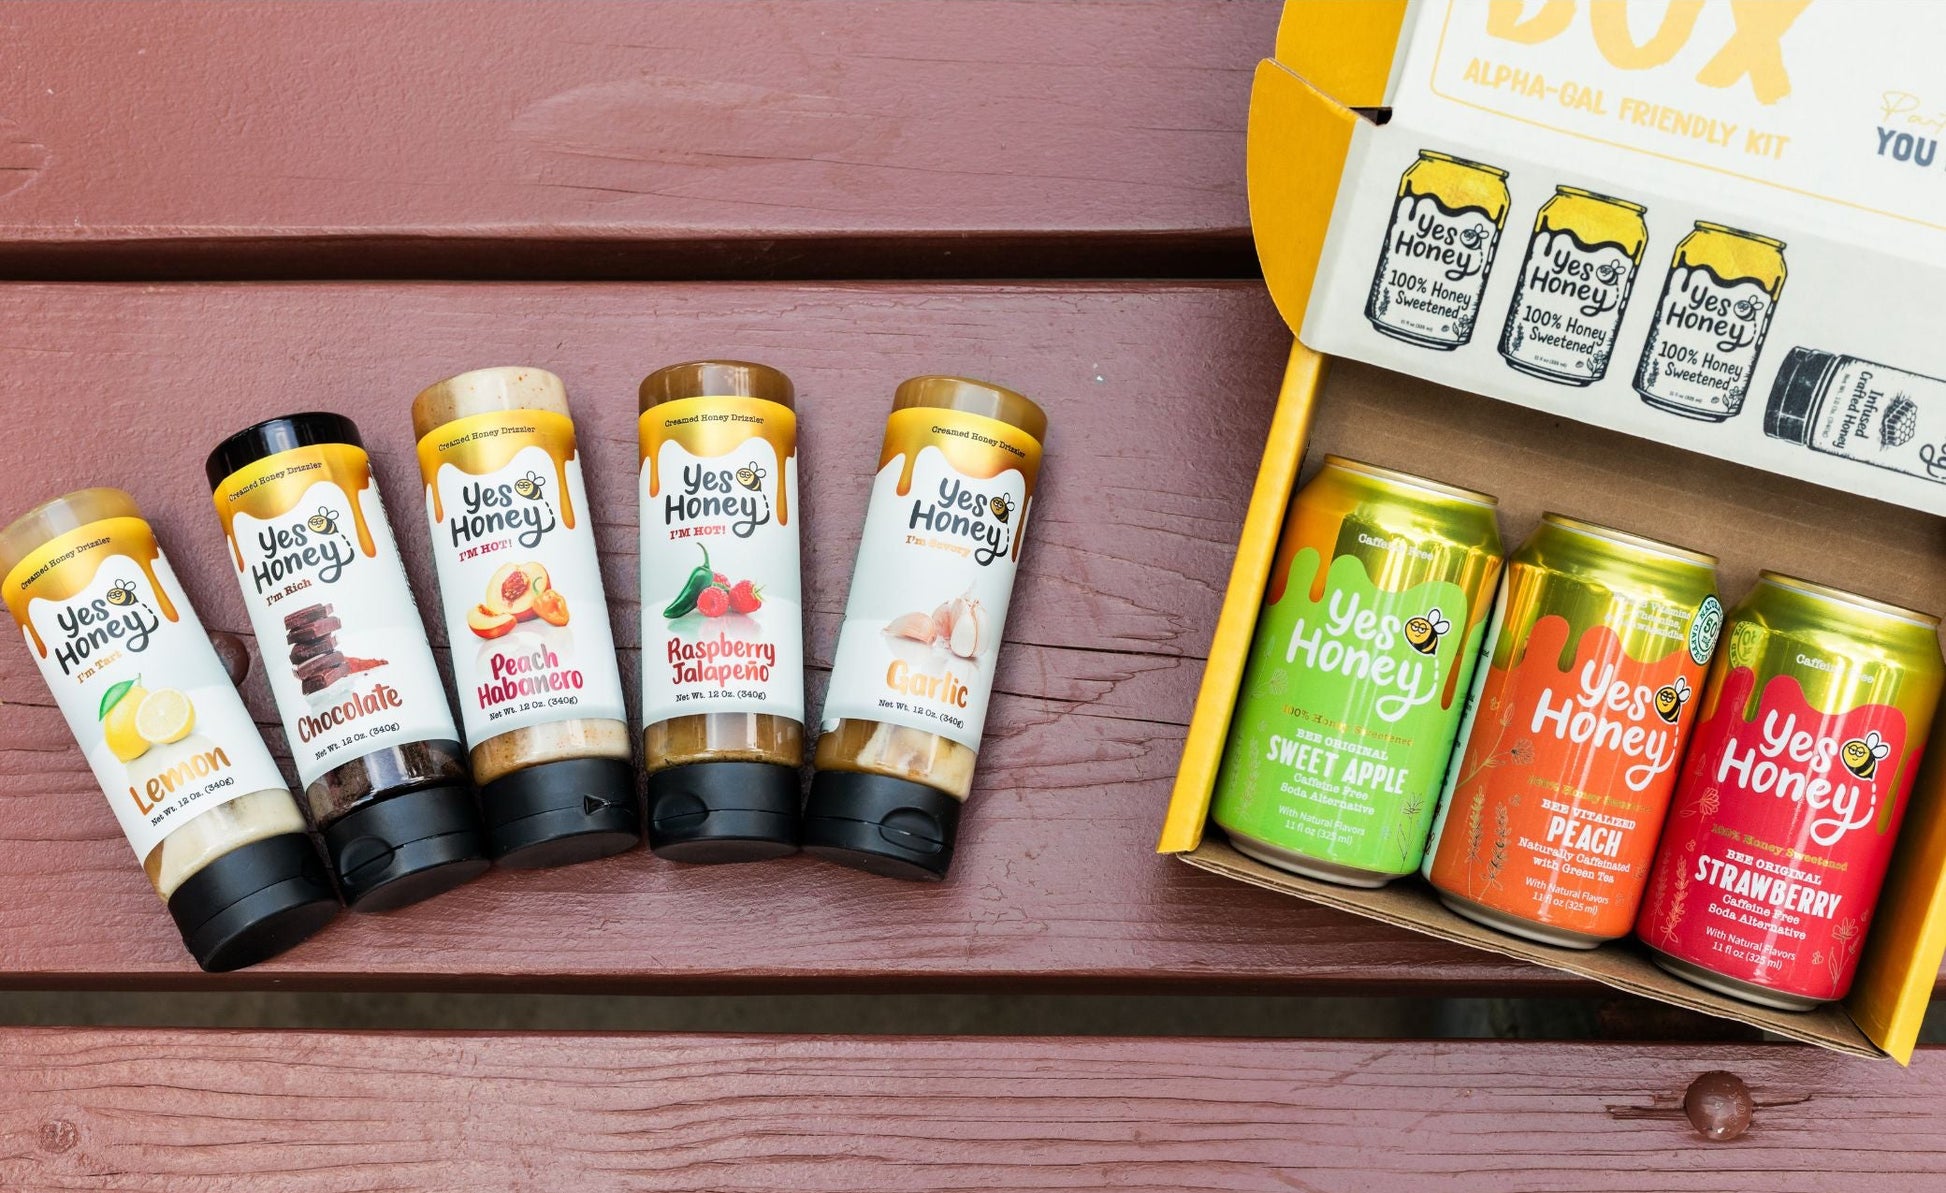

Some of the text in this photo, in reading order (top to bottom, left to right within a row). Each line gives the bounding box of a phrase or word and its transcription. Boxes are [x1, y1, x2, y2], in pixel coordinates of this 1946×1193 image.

[1463, 56, 1791, 160] ALPHA-GAL FRIENDLY KIT
[1877, 126, 1937, 167] YOU
[1416, 213, 1457, 245] Yes
[1395, 230, 1482, 281] Honey
[1552, 249, 1593, 281] Yes
[1389, 269, 1471, 310] 100% Honey
[1395, 290, 1460, 319] Sweetened
[1530, 266, 1617, 316] Honey
[1689, 285, 1731, 316] Yes
[1523, 305, 1606, 346] 100% Honey
[1530, 326, 1595, 354] Sweetened
[1666, 302, 1754, 352] Honey
[1659, 341, 1743, 382] 100% Honey
[1665, 362, 1731, 390] Sweetened
[1848, 371, 1873, 414] Crafted
[665, 414, 764, 427] Creamed Honey Drizzler
[1832, 414, 1856, 449] Honey
[1855, 389, 1884, 439] Infused
[438, 426, 536, 452] Creamed Honey Drizzler
[931, 426, 1026, 458] Creamed Honey Drizzler
[228, 461, 322, 502] Creamed Honey Drizzler
[684, 463, 733, 495] Yes
[938, 478, 987, 517] Yes
[463, 482, 512, 514] Yes
[665, 495, 770, 538] Honey
[259, 524, 308, 559] Yes
[451, 506, 555, 548] Honey
[693, 525, 726, 536] HOT!
[909, 500, 1008, 566] Honey
[21, 537, 111, 590] Creamed Honey Drizzler
[480, 539, 513, 554] HOT!
[252, 540, 355, 594] Honey
[284, 578, 312, 597] Rich
[57, 599, 109, 638] Yes
[1325, 588, 1400, 651] Yes
[55, 611, 159, 675] Honey
[95, 650, 122, 669] Tart
[490, 643, 558, 680] Peach
[667, 632, 775, 667] Raspberry
[886, 659, 968, 708] Garlic
[1286, 618, 1438, 722] Honey
[477, 670, 583, 709] Habanero
[489, 711, 502, 720] Net
[503, 706, 517, 715] Wt.
[519, 703, 530, 711] 12
[548, 696, 578, 708] (340g)
[676, 694, 690, 702] Net
[708, 690, 719, 698] 12
[721, 690, 735, 698] Oz.
[737, 690, 767, 700] (340g)
[1576, 659, 1653, 722] Yes
[298, 683, 402, 743] Chocolate
[878, 700, 964, 729] Net Wt. 12 Oz. (340g)
[315, 722, 400, 760] Net Wt. 12 Oz. (340g)
[1296, 728, 1389, 760] BEE ORIGINAL
[1530, 687, 1676, 792] Honey
[1760, 708, 1839, 773] Yes
[129, 747, 231, 816] Lemon
[1266, 734, 1409, 794] SWEET APPLE
[151, 776, 234, 827] Net Wt. 12 Oz. (340g)
[1280, 782, 1375, 816] Soda Alternative
[1294, 773, 1369, 801] Caffeine Free
[1716, 737, 1874, 846] Honey
[1278, 804, 1366, 836] With Natural Flavors
[1541, 798, 1636, 830] BEE VITALIZED
[1285, 820, 1352, 847] 11 fl oz (325 ml)
[1546, 815, 1623, 857] PEACH
[1518, 836, 1631, 873] Naturally Caffeinated
[1533, 857, 1614, 883] with Green Tea
[1726, 849, 1822, 886] BEE ORIGINAL
[1743, 833, 1784, 856] Honey
[1786, 847, 1848, 872] Sweetened
[1525, 876, 1609, 904] With Natural Flavors
[1532, 892, 1598, 916] 11 fl oz (325 ml)
[1695, 854, 1842, 920] STRAWBERRY
[1708, 903, 1807, 941] Soda Alternative
[1722, 893, 1801, 926] Caffeine Free
[1705, 925, 1796, 961] With Natural Flavors
[1712, 941, 1783, 971] 11 fl oz (325 ml)
